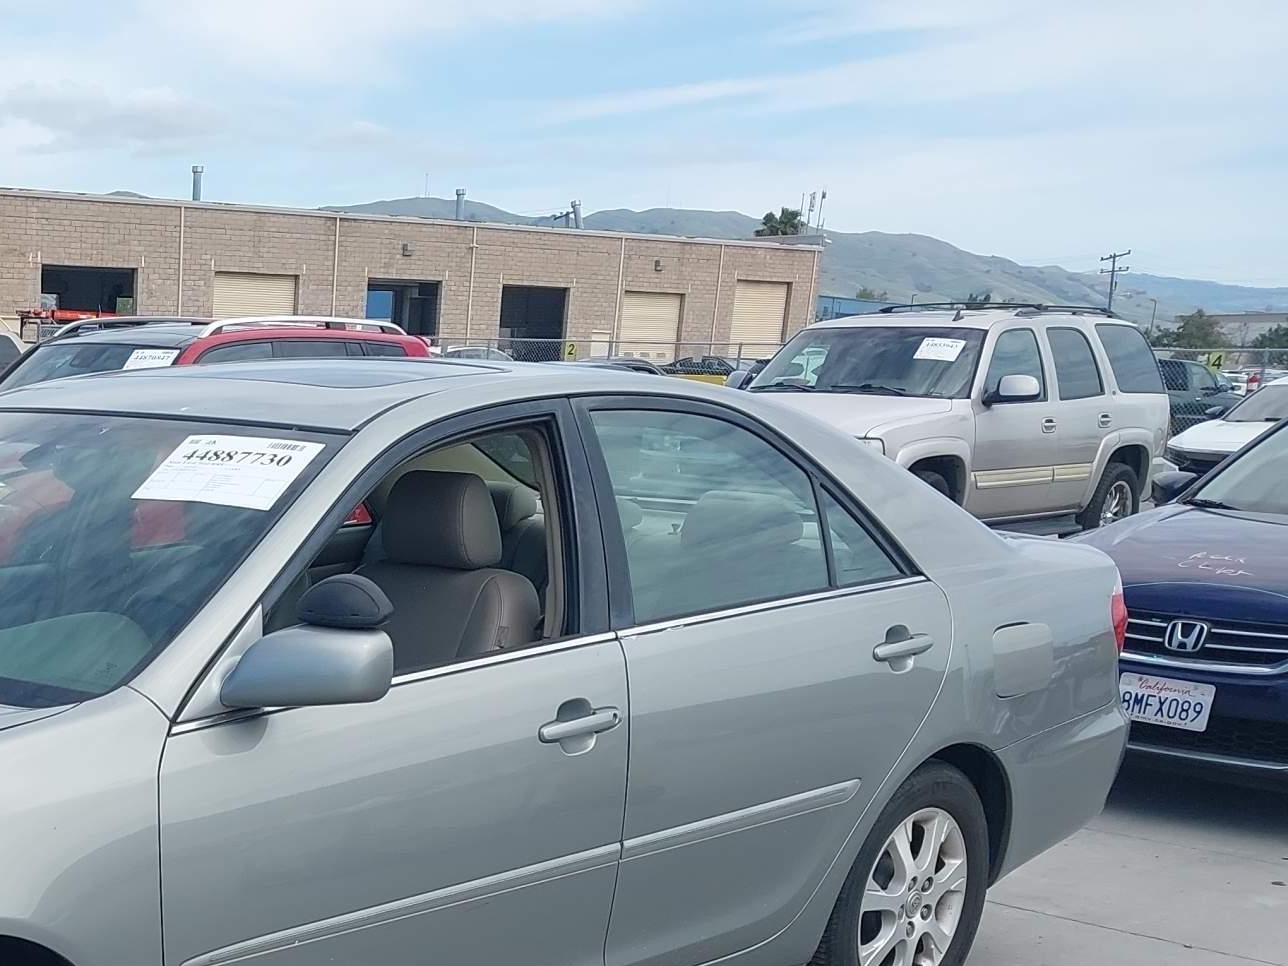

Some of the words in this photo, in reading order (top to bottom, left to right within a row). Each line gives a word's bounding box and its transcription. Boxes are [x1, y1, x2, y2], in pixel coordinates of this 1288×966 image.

[567, 343, 575, 356] 2
[1211, 354, 1222, 370] 4
[182, 448, 293, 468] 44887730
[1139, 679, 1194, 697] California
[1122, 690, 1204, 723] 8MFX089
